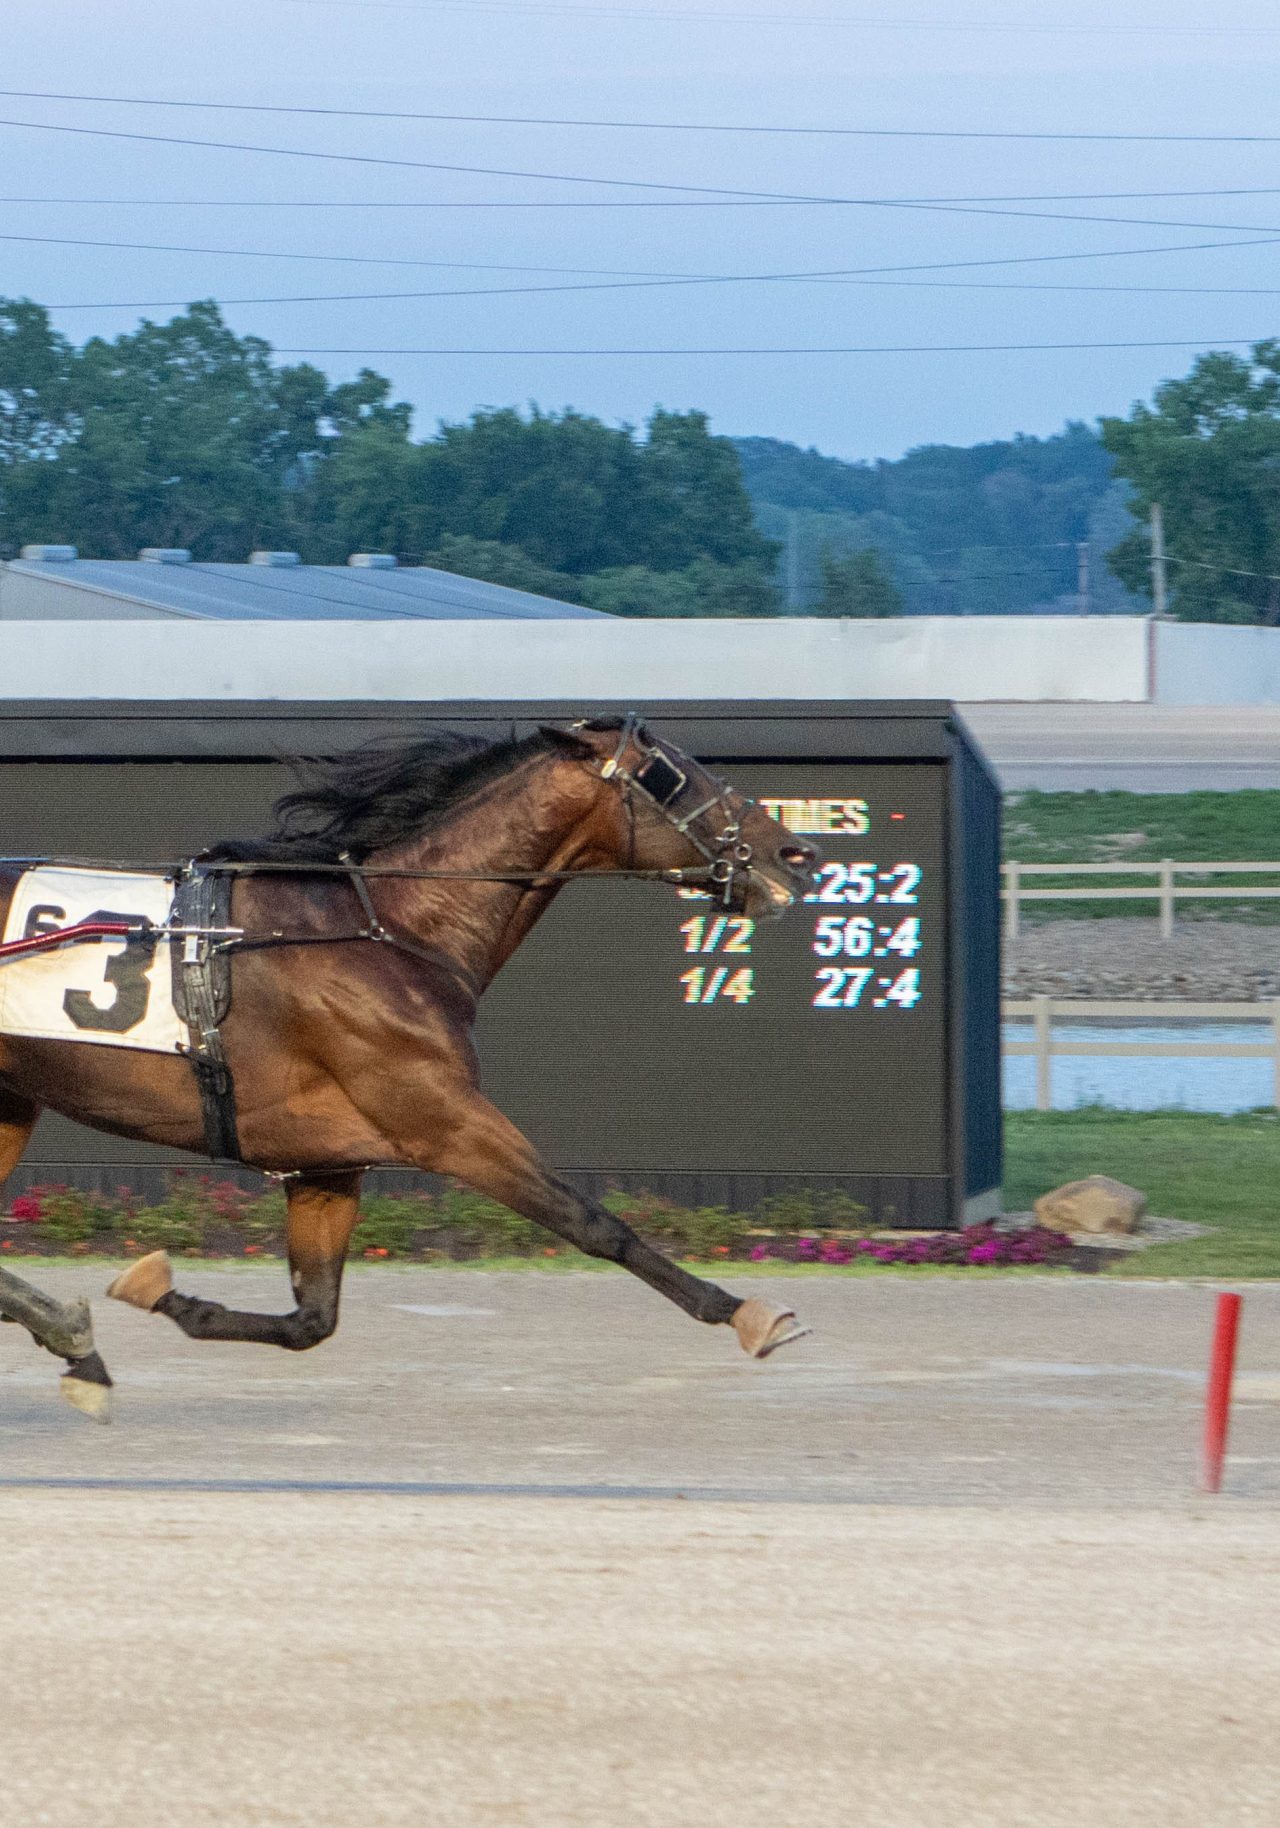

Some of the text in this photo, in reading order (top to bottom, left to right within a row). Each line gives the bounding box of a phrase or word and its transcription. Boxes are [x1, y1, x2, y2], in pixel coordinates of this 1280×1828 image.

[803, 862, 923, 903] :25:2
[23, 904, 66, 950] 6
[678, 915, 923, 957] 1/2 56:4
[62, 909, 157, 1034] 3
[678, 966, 923, 1008] 1/4 27:4
